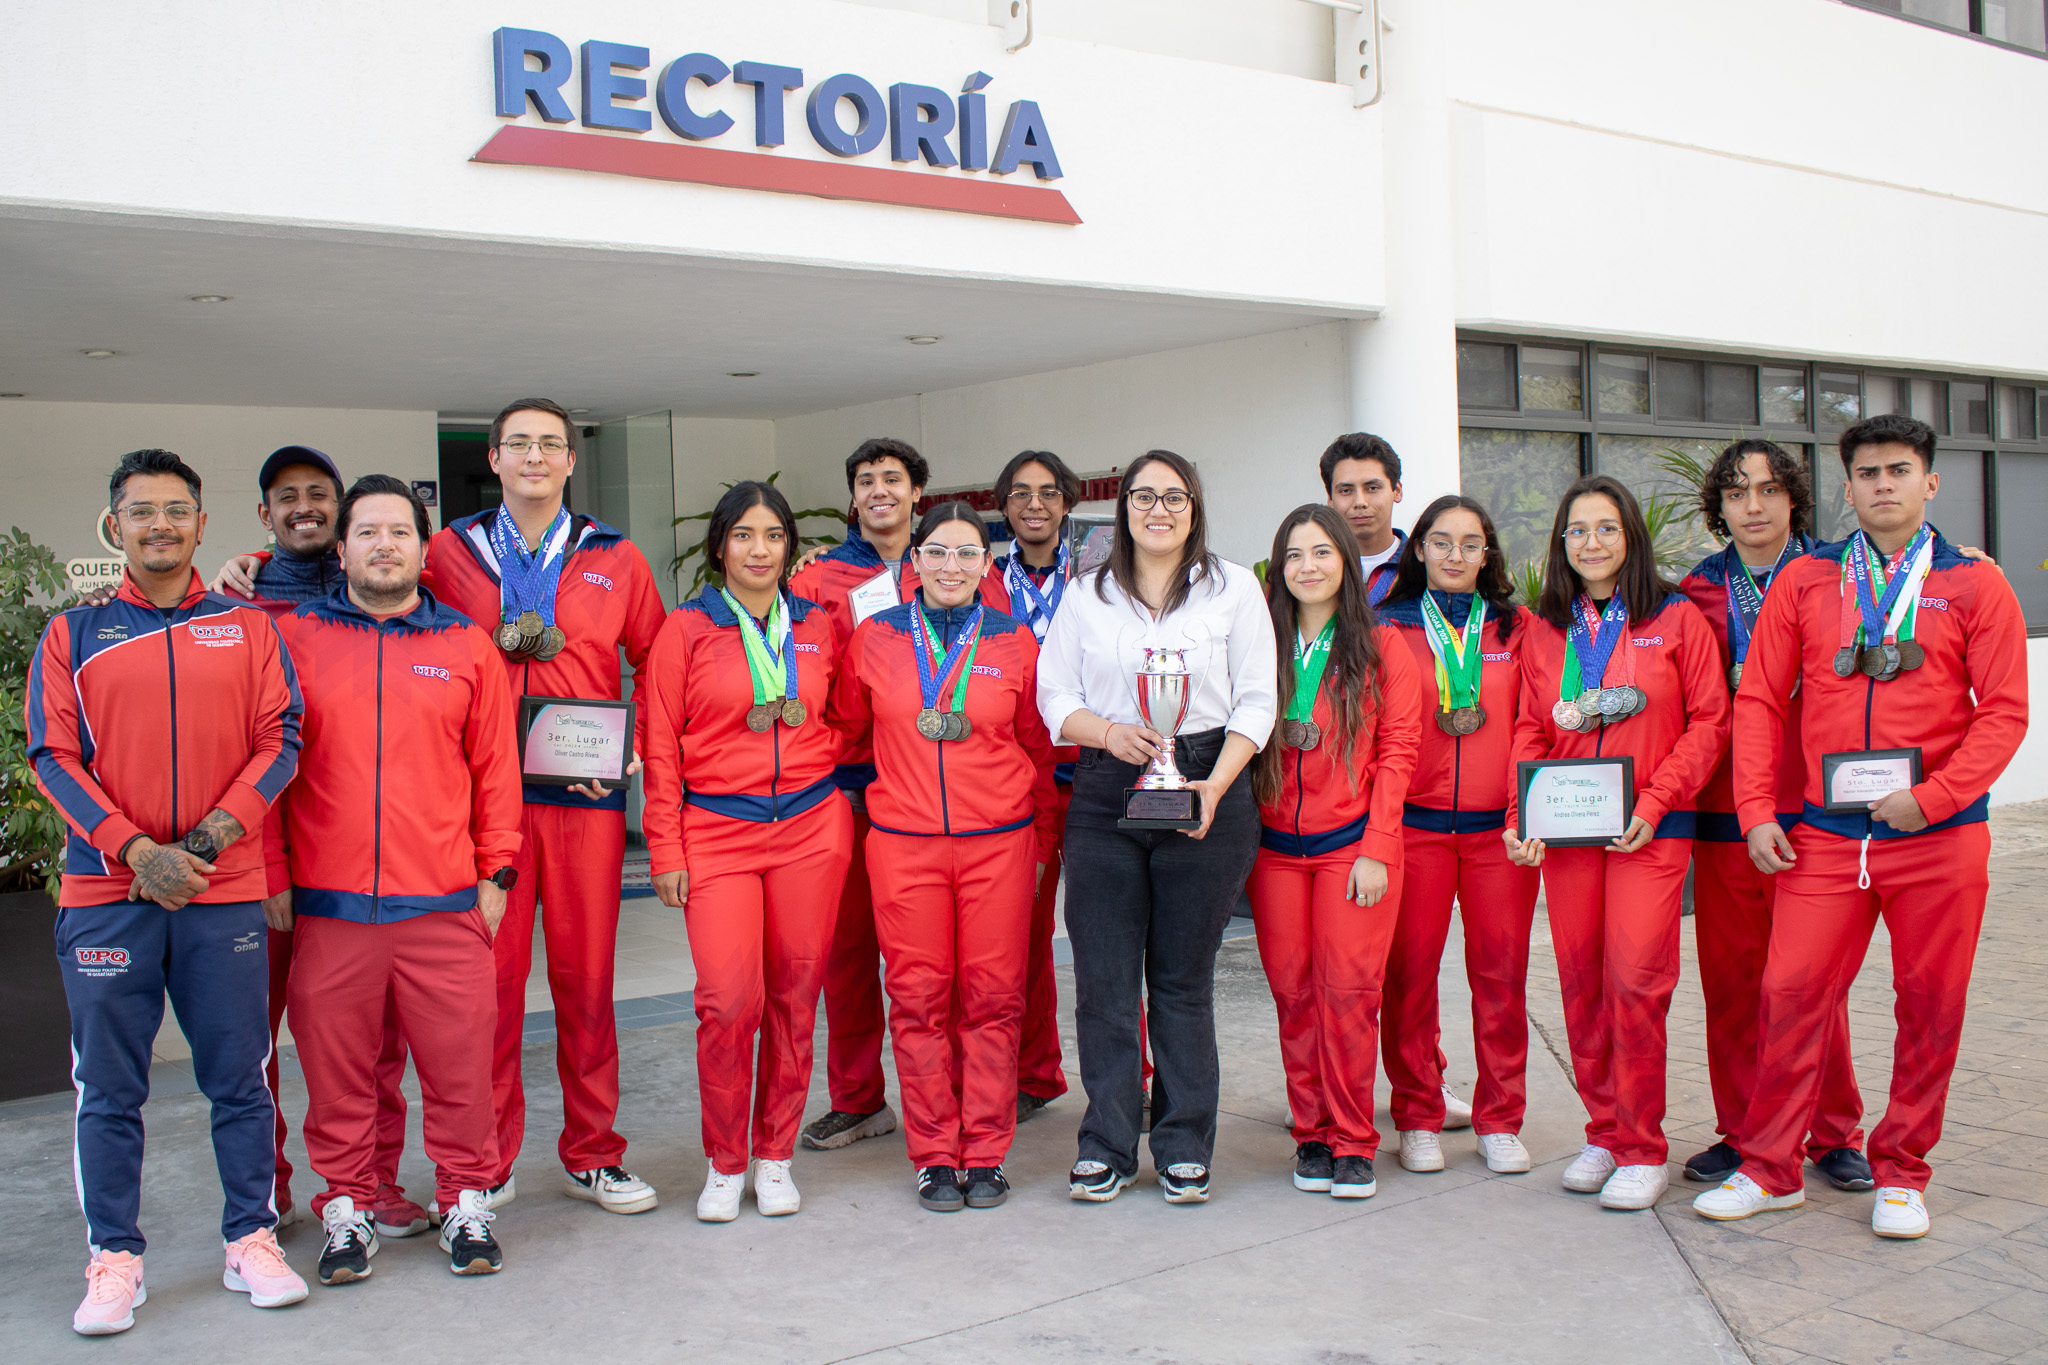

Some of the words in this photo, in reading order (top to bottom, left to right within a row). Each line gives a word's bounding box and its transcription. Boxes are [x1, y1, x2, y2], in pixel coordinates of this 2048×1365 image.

[492, 26, 1064, 181] RECTORÍA
[497, 520, 506, 542] LUGAR
[503, 516, 519, 539] LUGAR
[1854, 540, 1863, 562] LUGAR
[582, 571, 613, 591] UPQ
[1856, 562, 1866, 581] 2024
[1873, 565, 1885, 585] 2024
[1020, 577, 1033, 590] 2024
[1731, 575, 1751, 614] MASTER
[910, 606, 920, 629] LUGAR
[1428, 608, 1442, 630] LUGAR
[1438, 628, 1450, 645] 2024
[189, 625, 244, 639] UPQ
[913, 629, 923, 647] 2024
[412, 664, 450, 681] UPQ
[547, 732, 570, 742] 3er.
[576, 734, 610, 746] Lugar
[569, 750, 585, 758] Castro
[1545, 795, 1568, 804] 3er.
[1574, 794, 1608, 804] Lugar
[76, 947, 131, 967] UPQ
